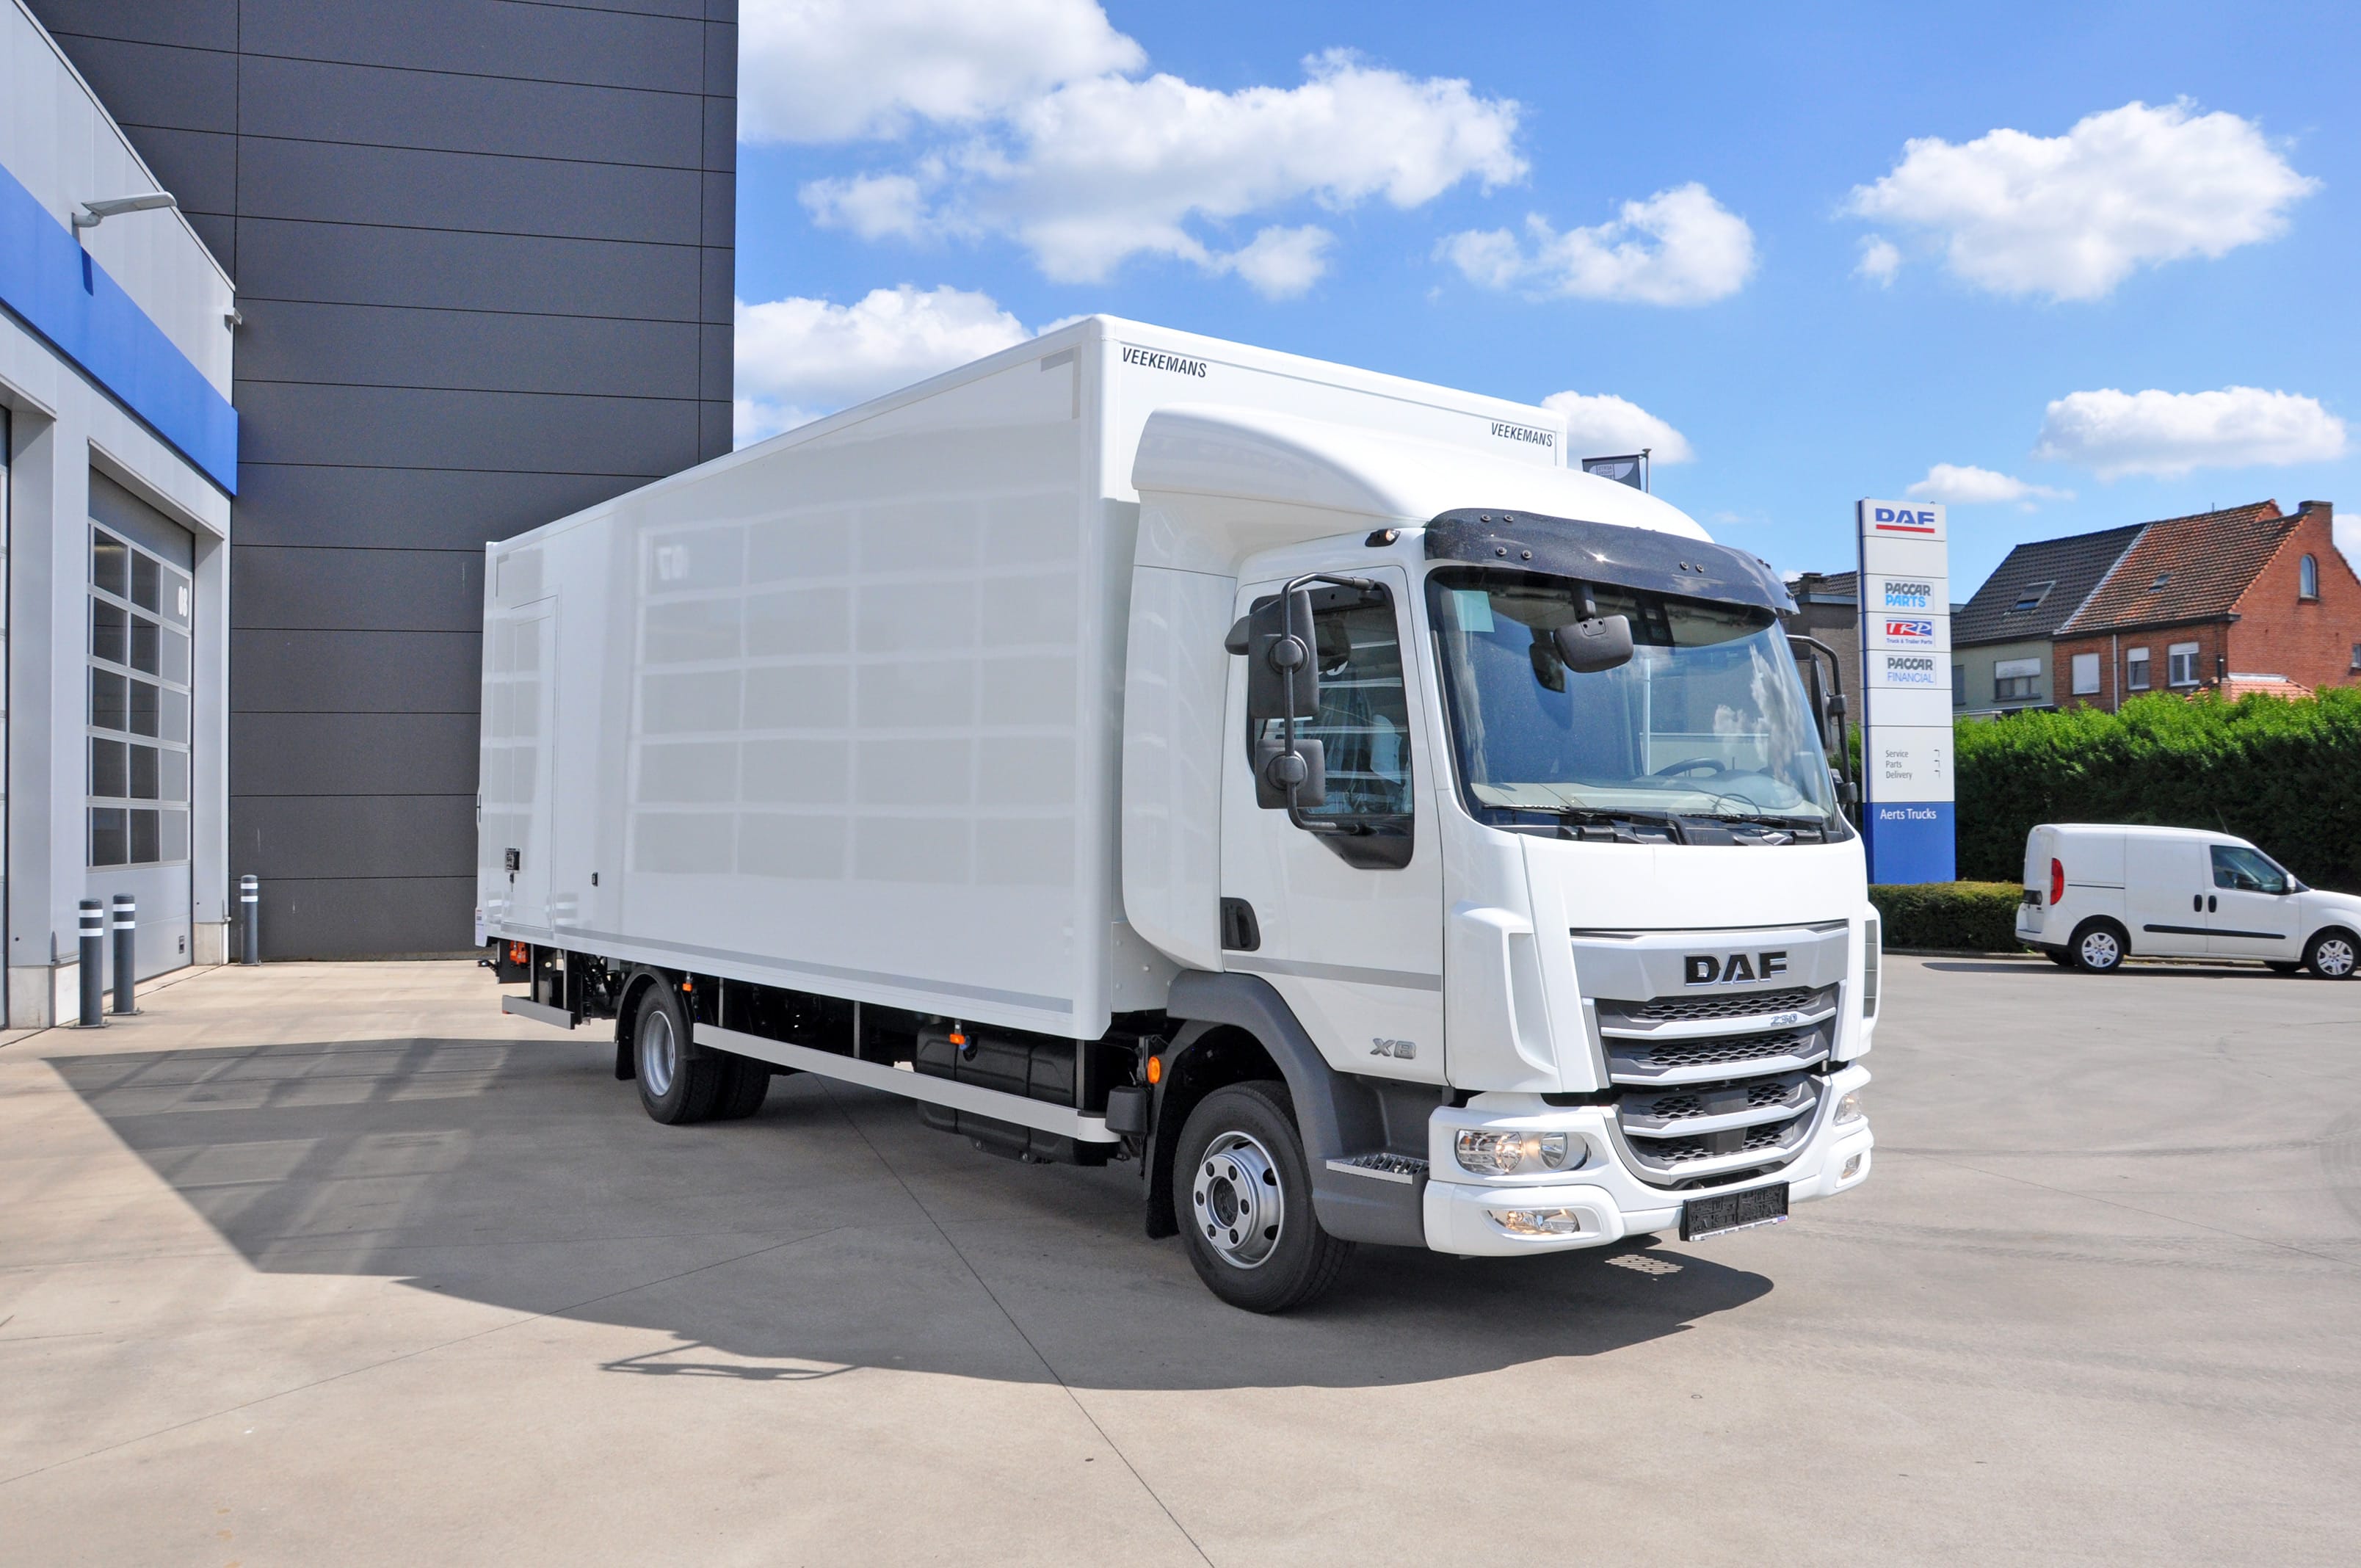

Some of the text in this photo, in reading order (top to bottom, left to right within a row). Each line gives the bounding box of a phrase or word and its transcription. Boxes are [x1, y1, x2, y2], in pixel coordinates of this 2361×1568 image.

[1122, 346, 1207, 378] VEEKEMANS
[1490, 421, 1553, 447] VEEKEMANS
[1875, 508, 1934, 525] DAF
[1885, 582, 1931, 596] PACCAR
[1885, 595, 1926, 608] PARTS
[1886, 622, 1932, 636] TRP
[1887, 657, 1933, 670] PACCAR
[1887, 672, 1934, 683] FINANCIAL
[1885, 749, 1909, 758] Service
[1885, 771, 1912, 780] Delivery
[1879, 808, 1937, 819] Aerts Trucks
[1684, 951, 1787, 986] DAF
